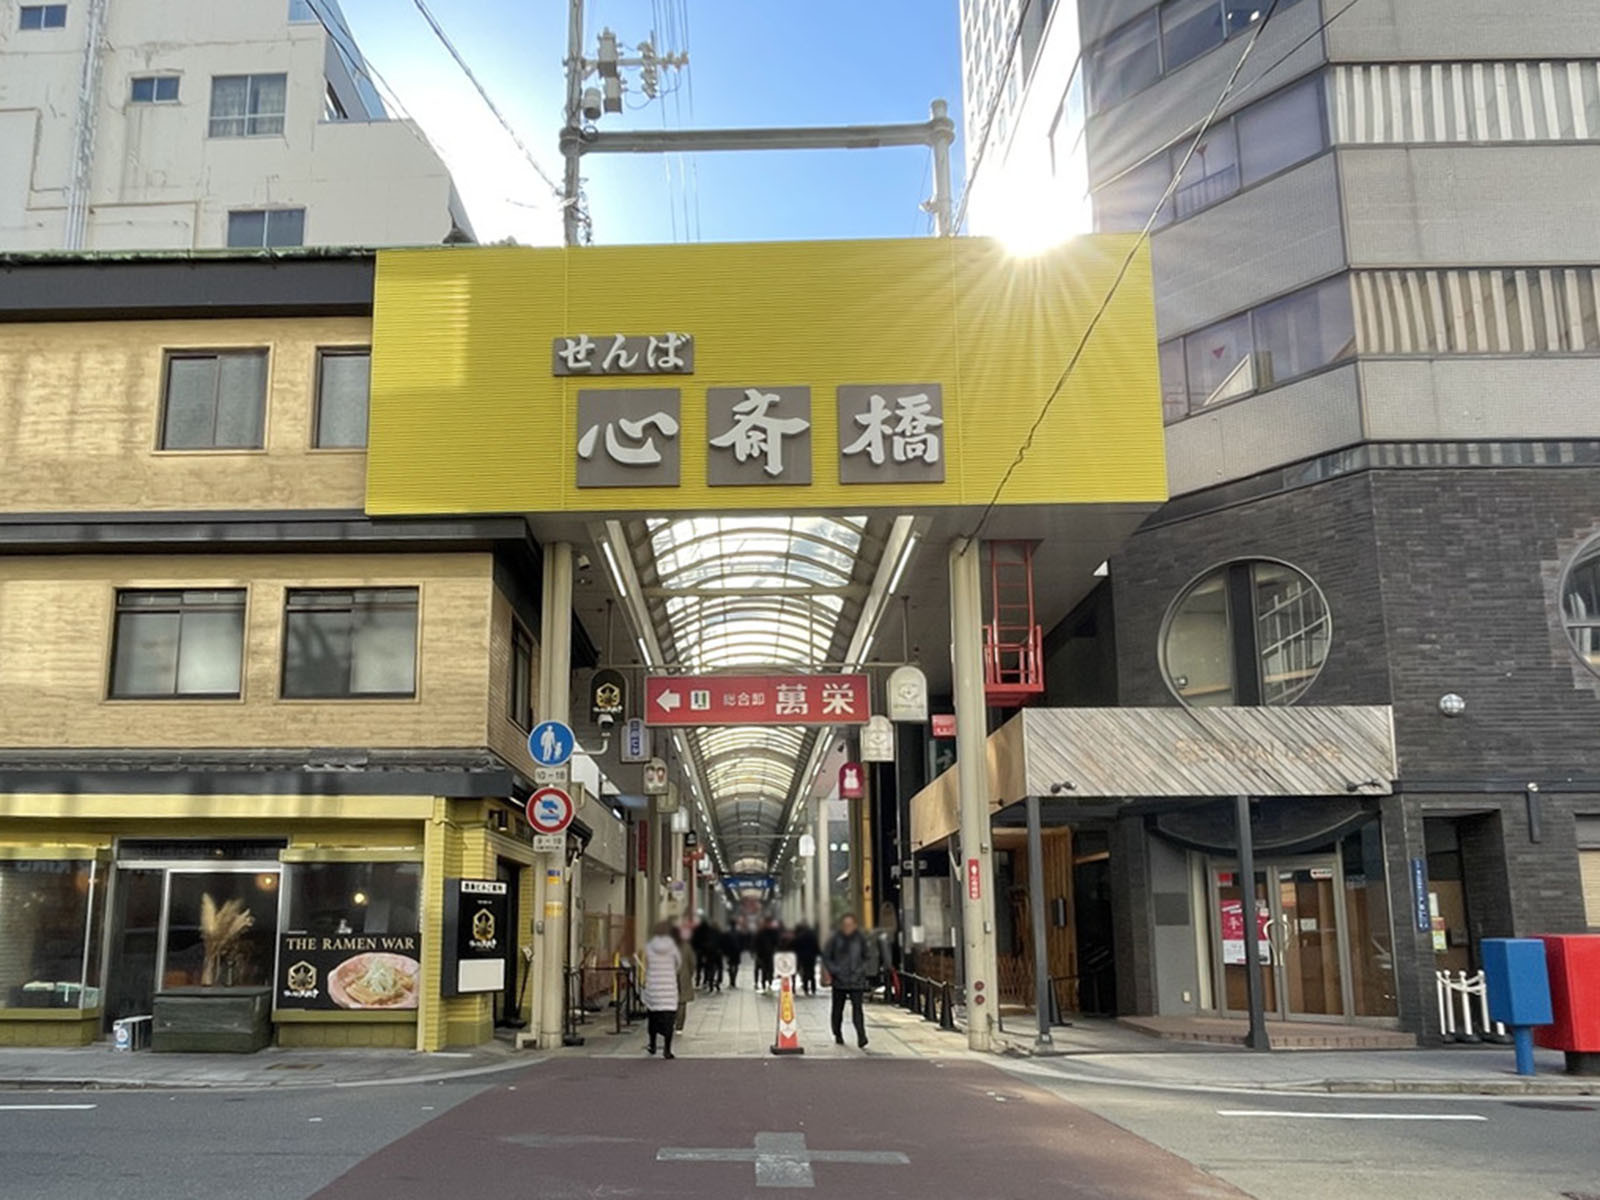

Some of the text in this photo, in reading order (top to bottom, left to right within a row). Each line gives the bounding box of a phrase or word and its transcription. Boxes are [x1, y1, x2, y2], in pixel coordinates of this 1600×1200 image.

[558, 332, 691, 372] せんば
[577, 388, 944, 476] 心斎橋
[775, 683, 855, 716] 萬栄
[286, 937, 415, 950] THE RAMEN WAR
